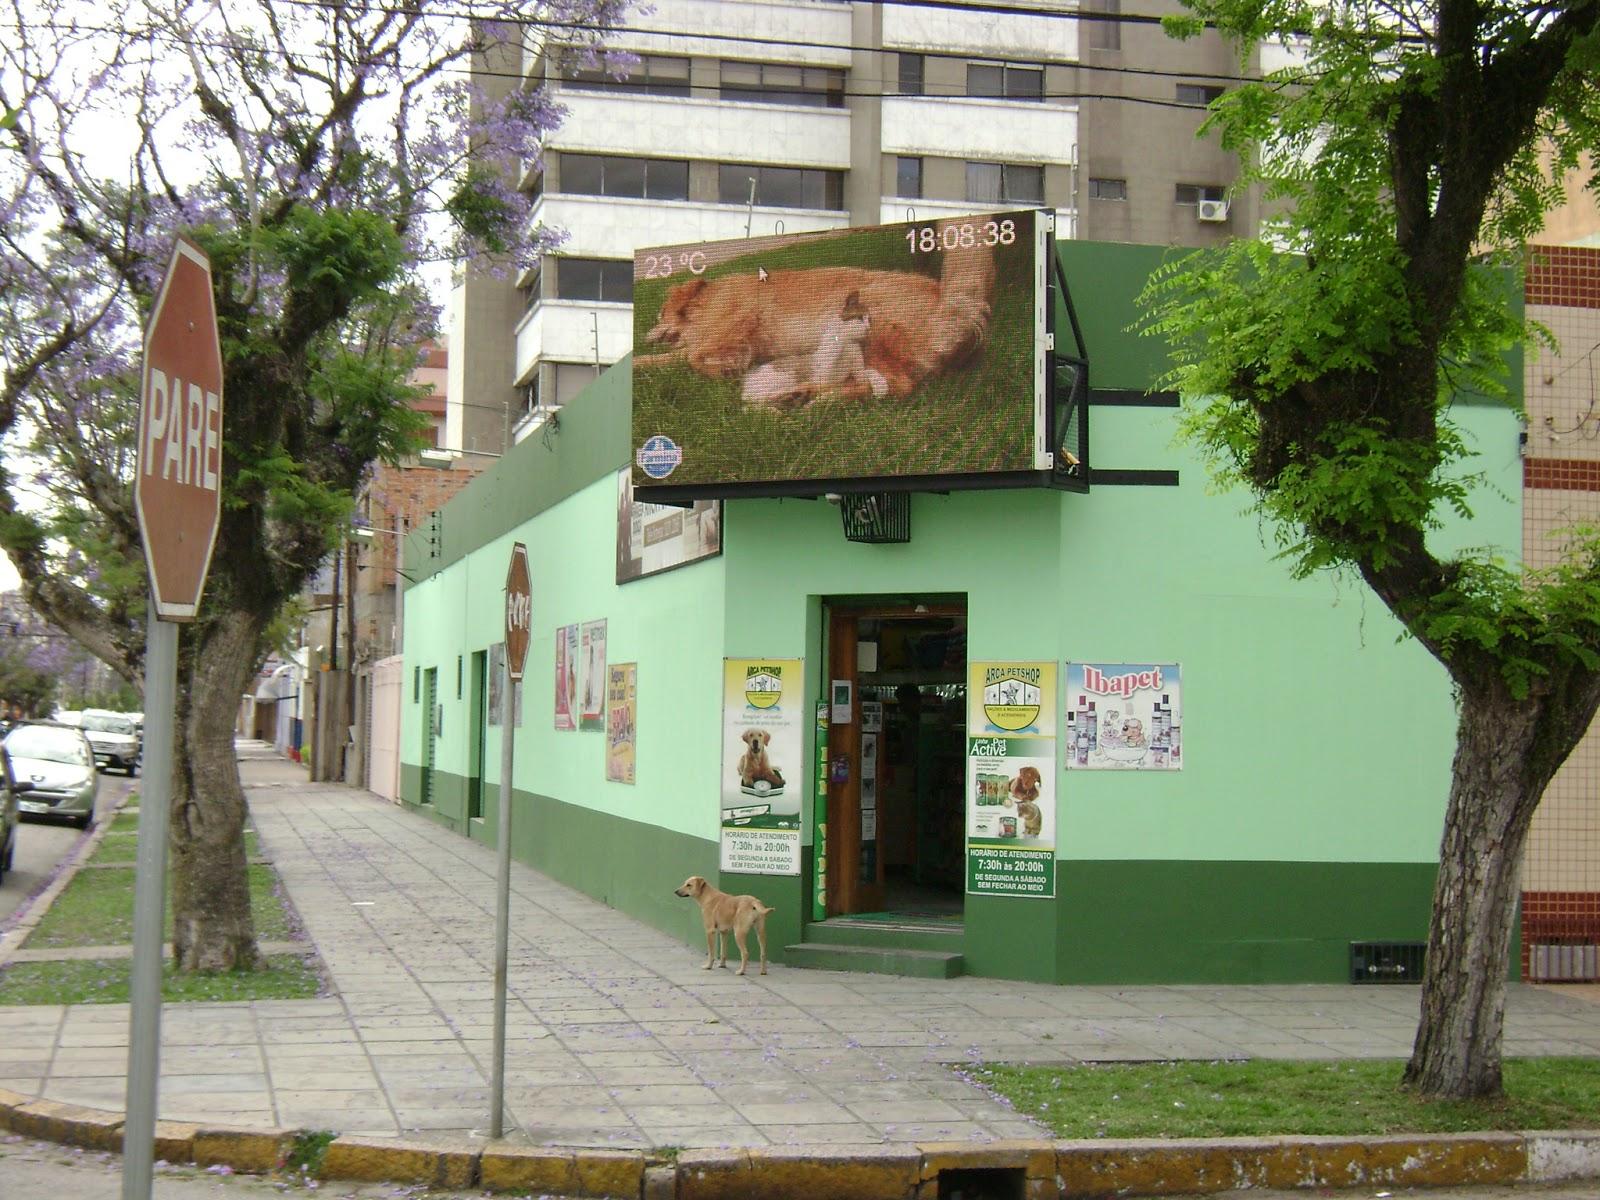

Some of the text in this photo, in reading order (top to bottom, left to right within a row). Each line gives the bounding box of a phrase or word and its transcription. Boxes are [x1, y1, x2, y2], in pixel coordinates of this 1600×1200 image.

[905, 219, 1016, 254] 18:08:38
[645, 253, 673, 279] 23
[145, 367, 218, 491] PARE
[985, 667, 1041, 684] ARCA PETSHOP
[1083, 666, 1162, 698] Ibapet
[993, 737, 1006, 747] Pet
[970, 743, 1007, 756] Active
[732, 841, 752, 851] 7:30h
[764, 842, 790, 852] 20:00h
[970, 848, 1052, 859] HORÁRIO DE ATENDIMENTO
[978, 859, 1002, 870] 7:30h
[1014, 861, 1044, 872] 20:00h
[975, 873, 984, 881] DE
[984, 874, 1014, 882] SEGUNDA
[977, 881, 991, 889] SEM
[991, 882, 1017, 890] FECHAR
